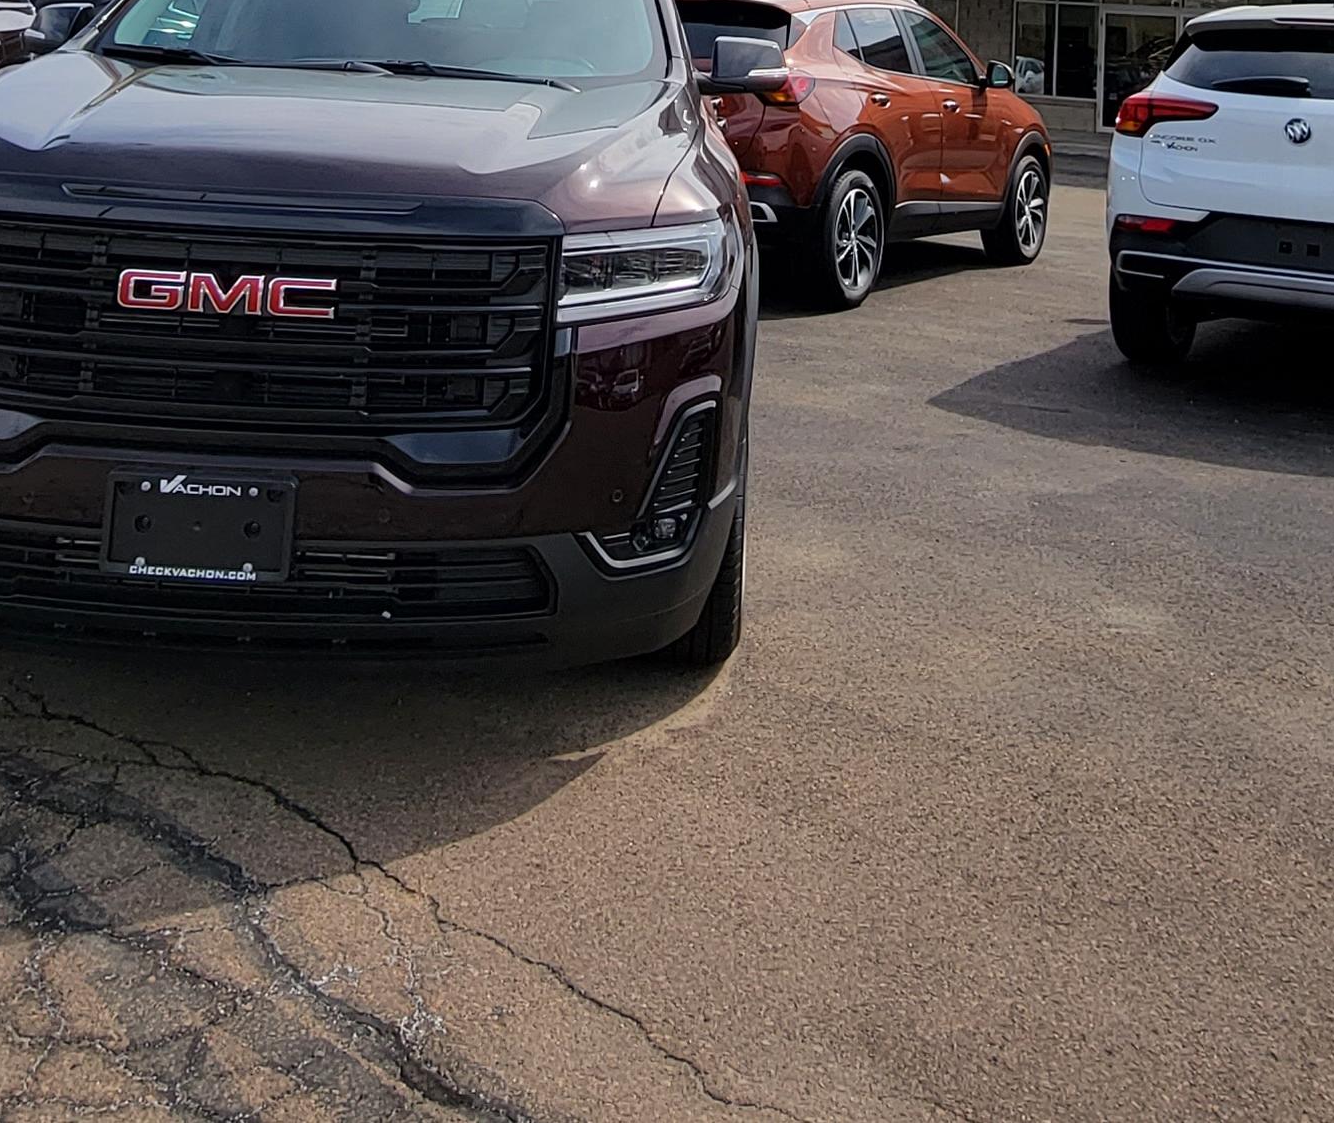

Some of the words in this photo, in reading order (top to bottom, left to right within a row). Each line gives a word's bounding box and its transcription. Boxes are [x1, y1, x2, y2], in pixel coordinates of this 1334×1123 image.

[117, 268, 337, 319] GMC
[160, 475, 241, 496] VACHON
[129, 565, 257, 581] CHECKVACHON.COM
